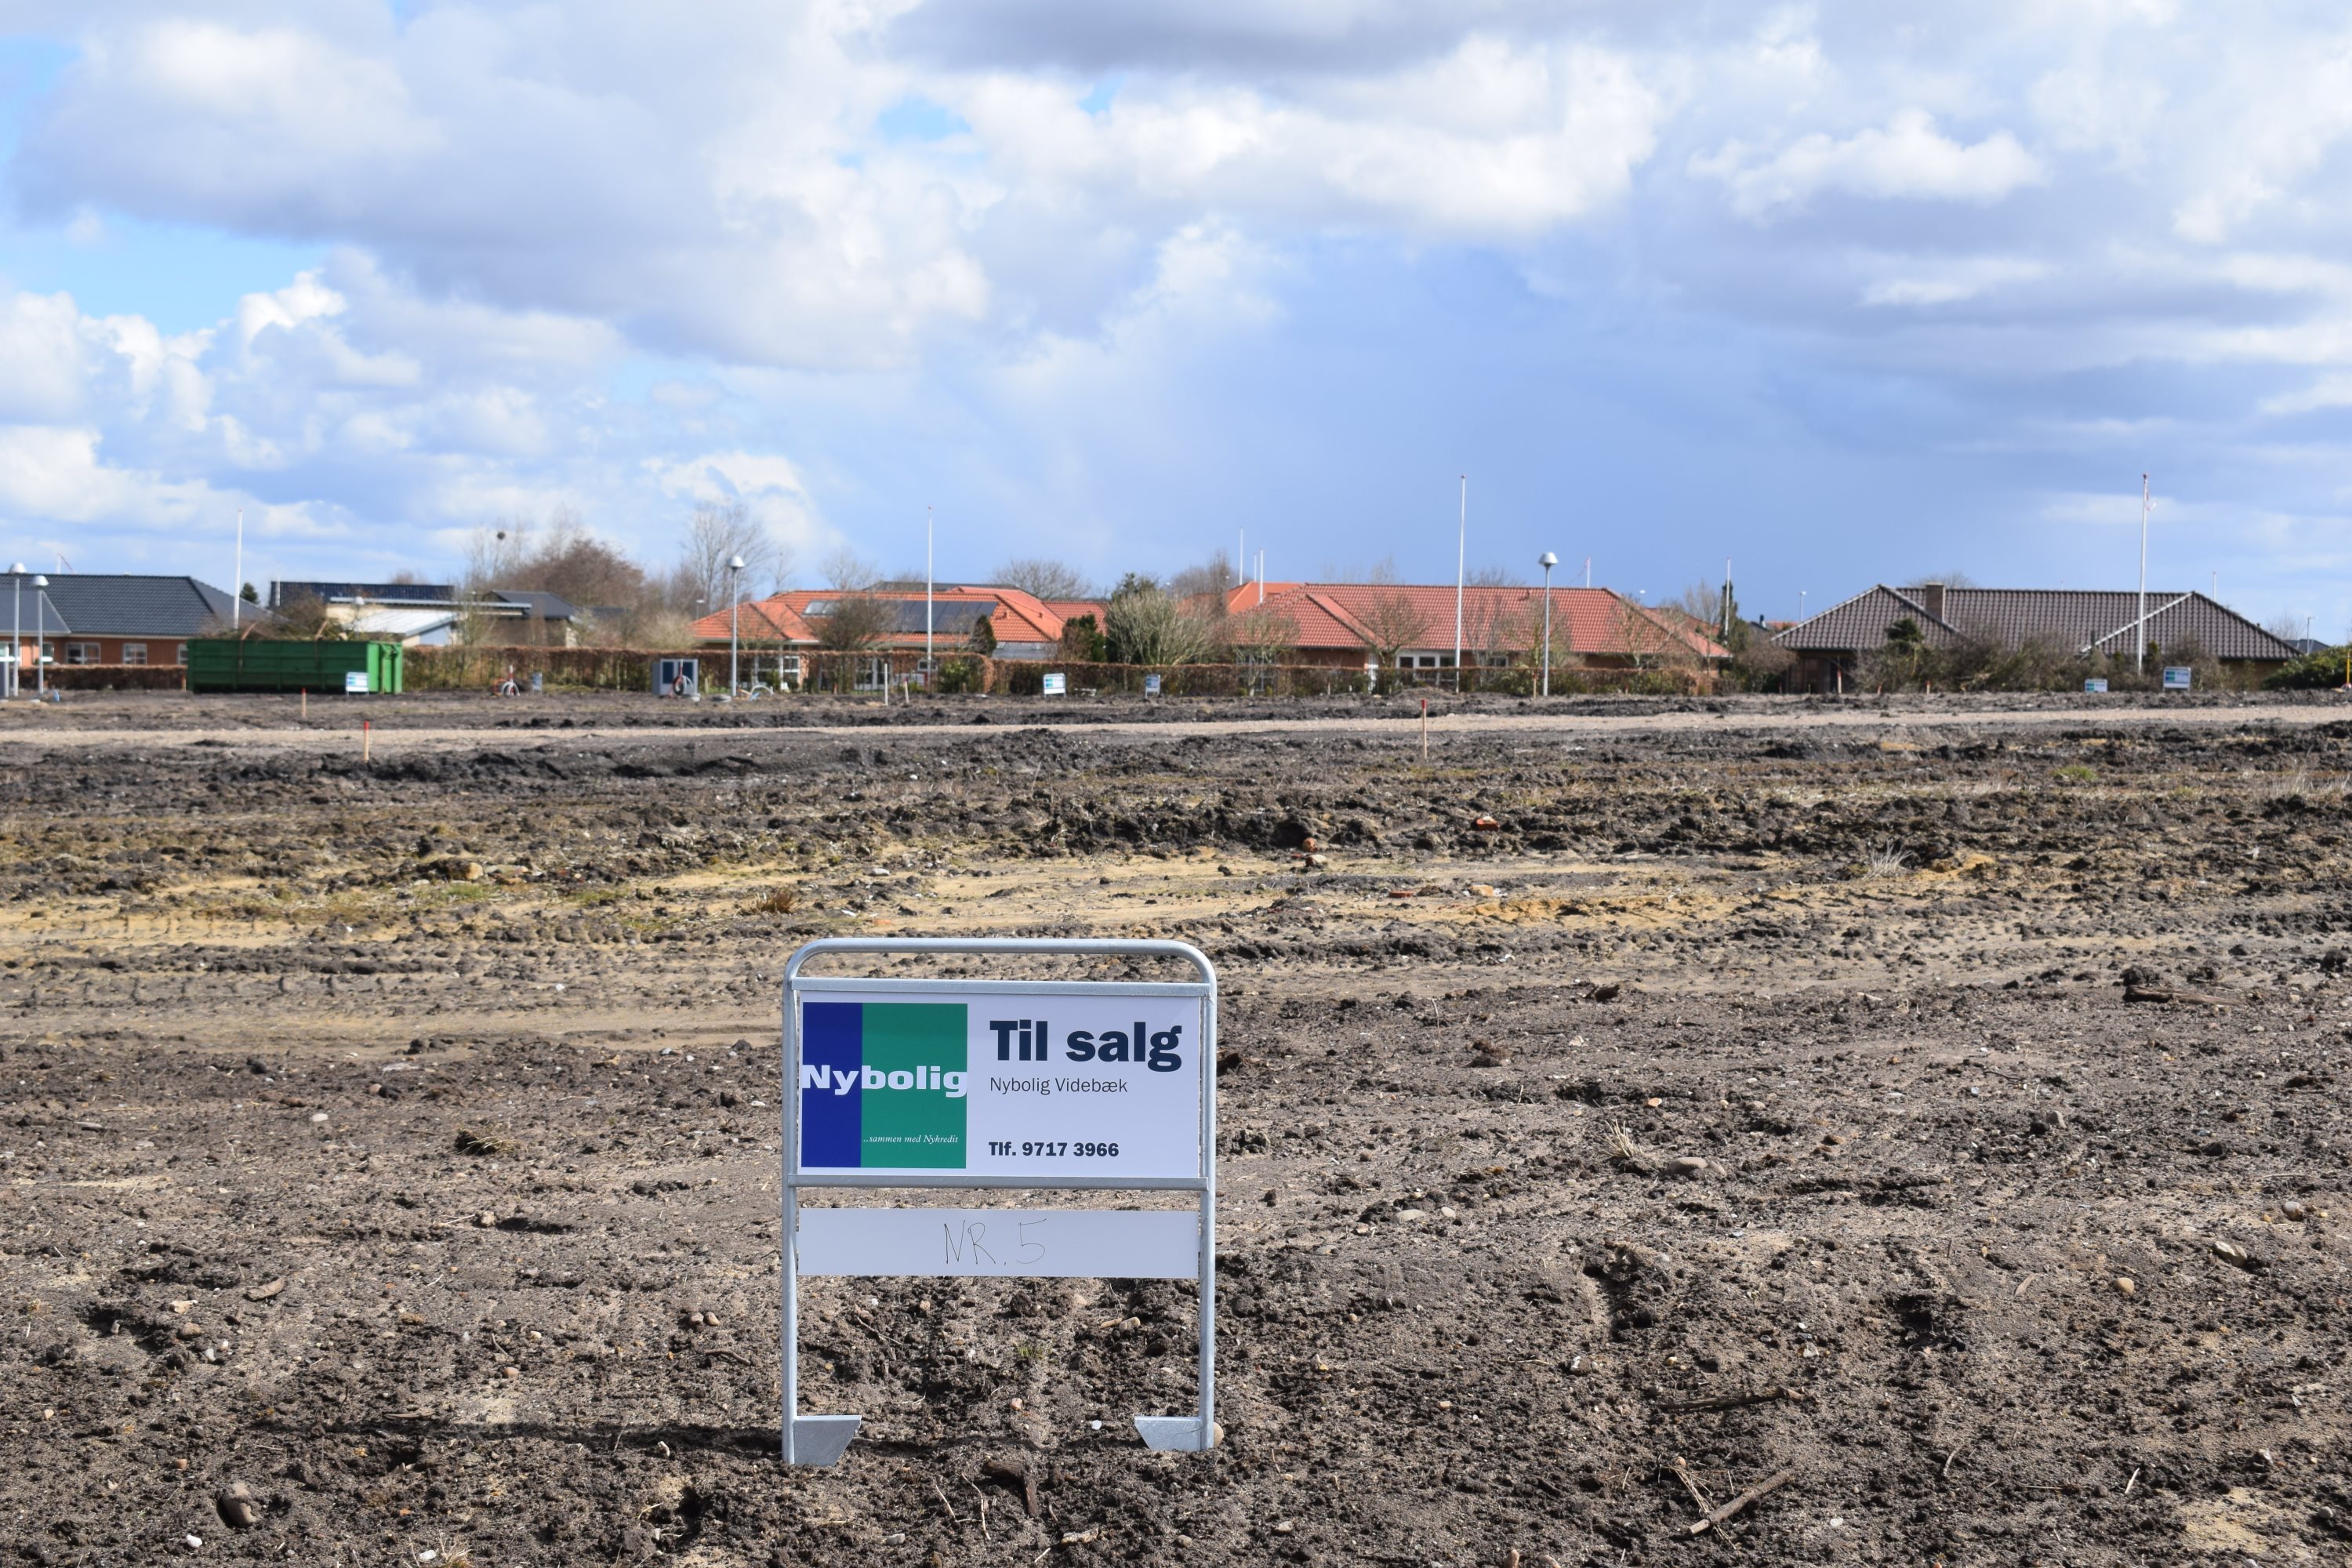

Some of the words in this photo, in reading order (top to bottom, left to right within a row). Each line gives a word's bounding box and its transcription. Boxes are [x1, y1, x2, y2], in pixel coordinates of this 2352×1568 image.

[989, 1019, 1048, 1061] Til
[1065, 1022, 1182, 1072] salg
[801, 1064, 967, 1097] Nybolig
[989, 1077, 1051, 1094] Nybolig
[1054, 1078, 1128, 1093] Videbæk
[923, 1134, 959, 1144] Nykredit
[989, 1142, 1017, 1156] Tlf.
[1022, 1142, 1068, 1156] 9717
[1073, 1143, 1120, 1157] 3966
[1016, 1218, 1047, 1265] 5
